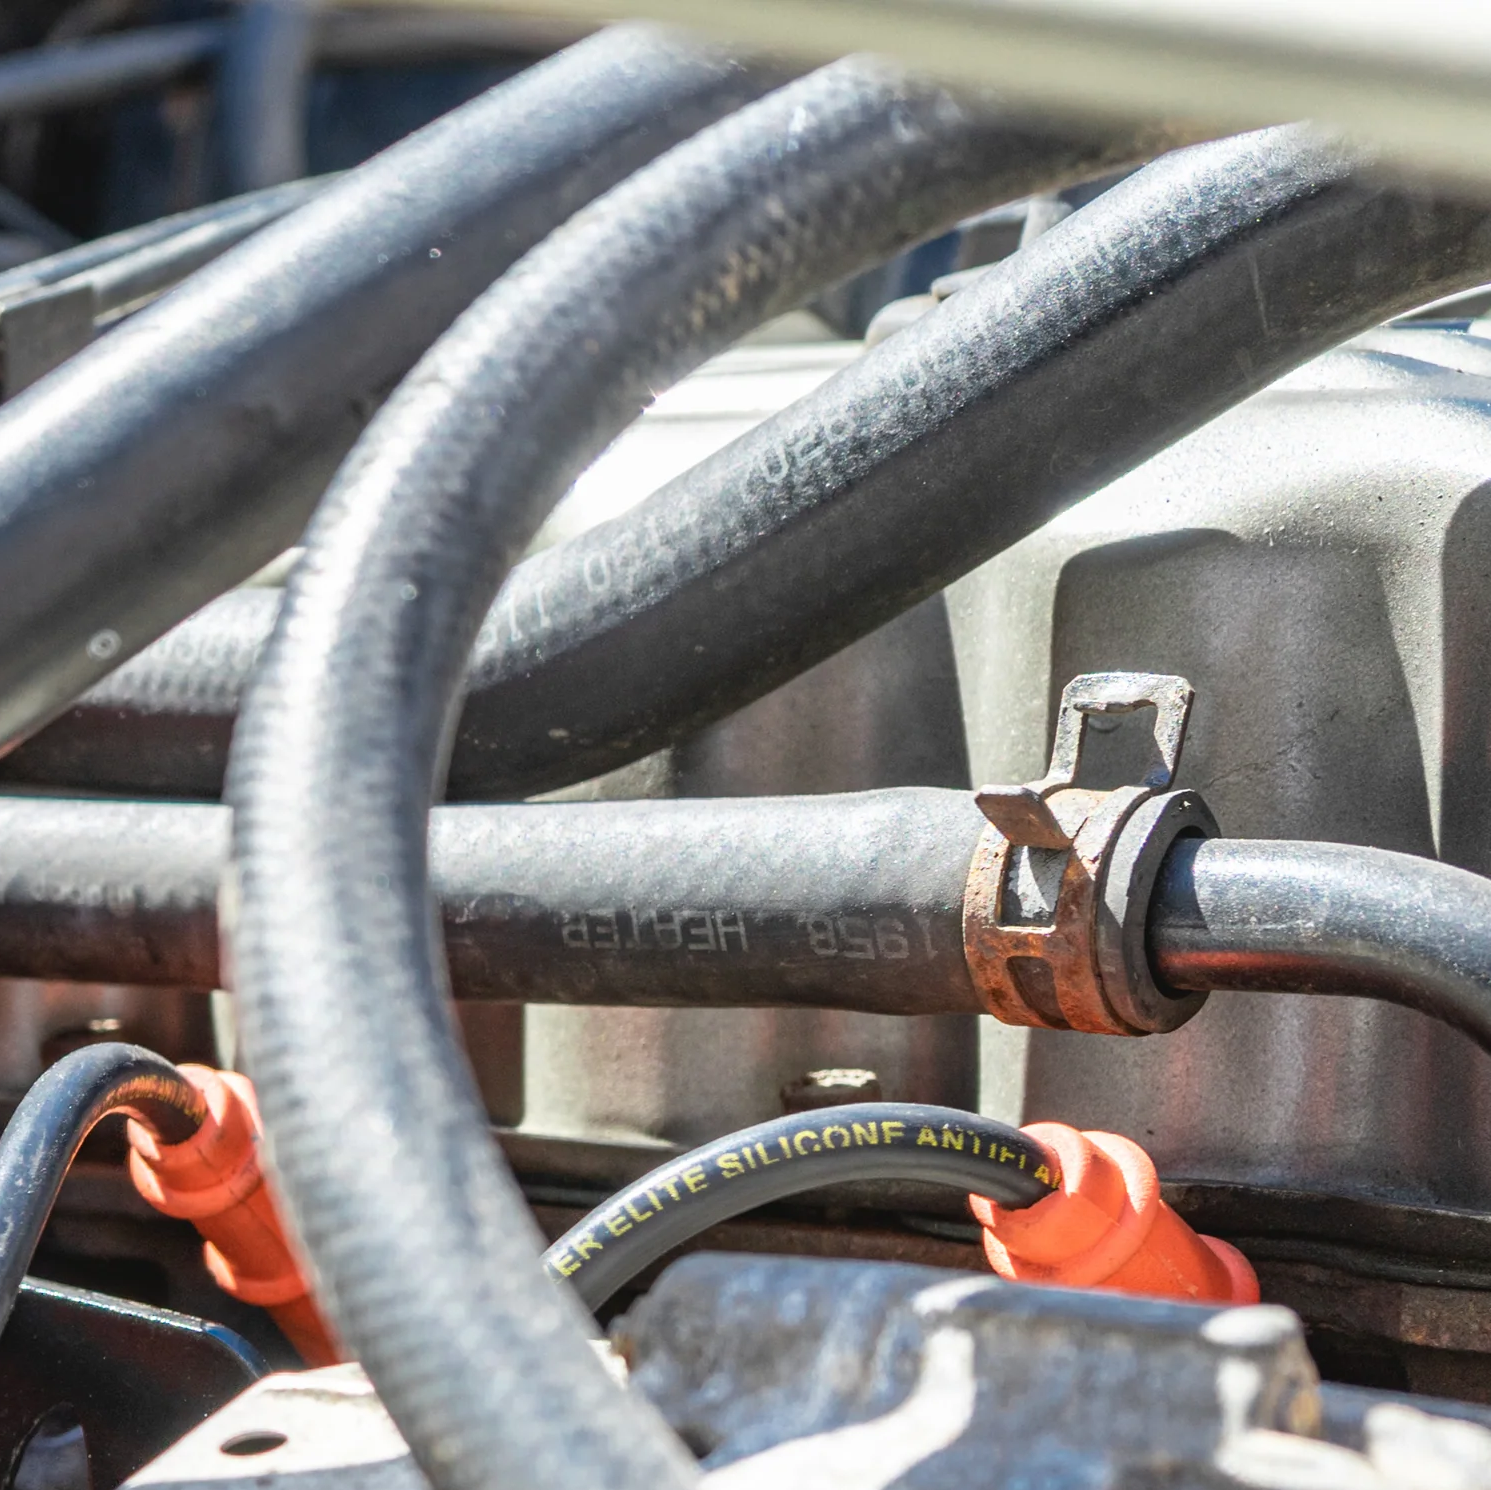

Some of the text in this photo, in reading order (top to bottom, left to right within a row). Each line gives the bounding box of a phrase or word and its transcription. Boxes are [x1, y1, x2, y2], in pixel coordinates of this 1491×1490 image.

[562, 906, 749, 953] HEATER
[604, 1164, 711, 1238] ELITE
[717, 1120, 905, 1180] SILICONE
